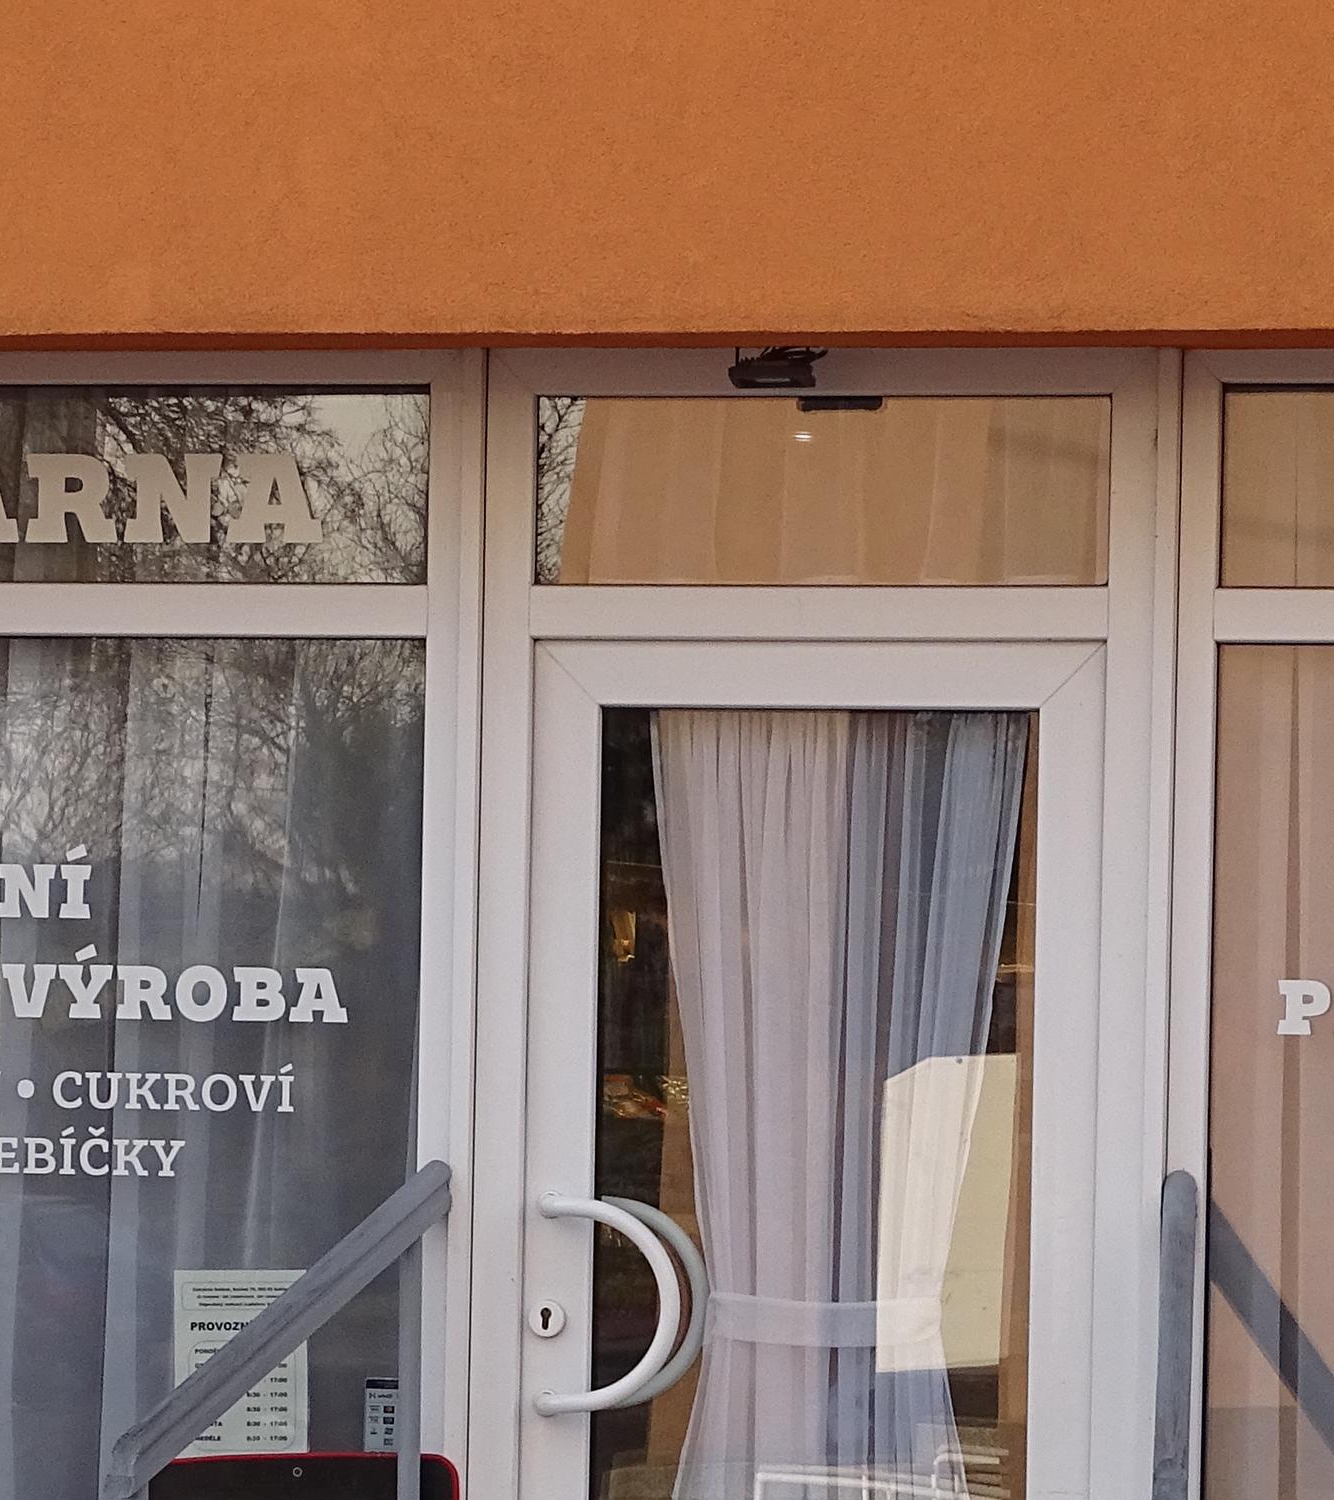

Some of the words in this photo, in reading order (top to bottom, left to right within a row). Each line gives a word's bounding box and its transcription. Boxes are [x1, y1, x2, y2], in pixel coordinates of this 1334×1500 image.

[2, 944, 349, 1024] VÝROBA
[52, 1063, 295, 1113] CUKROVÍ
[190, 1321, 249, 1331] PROVOZN
